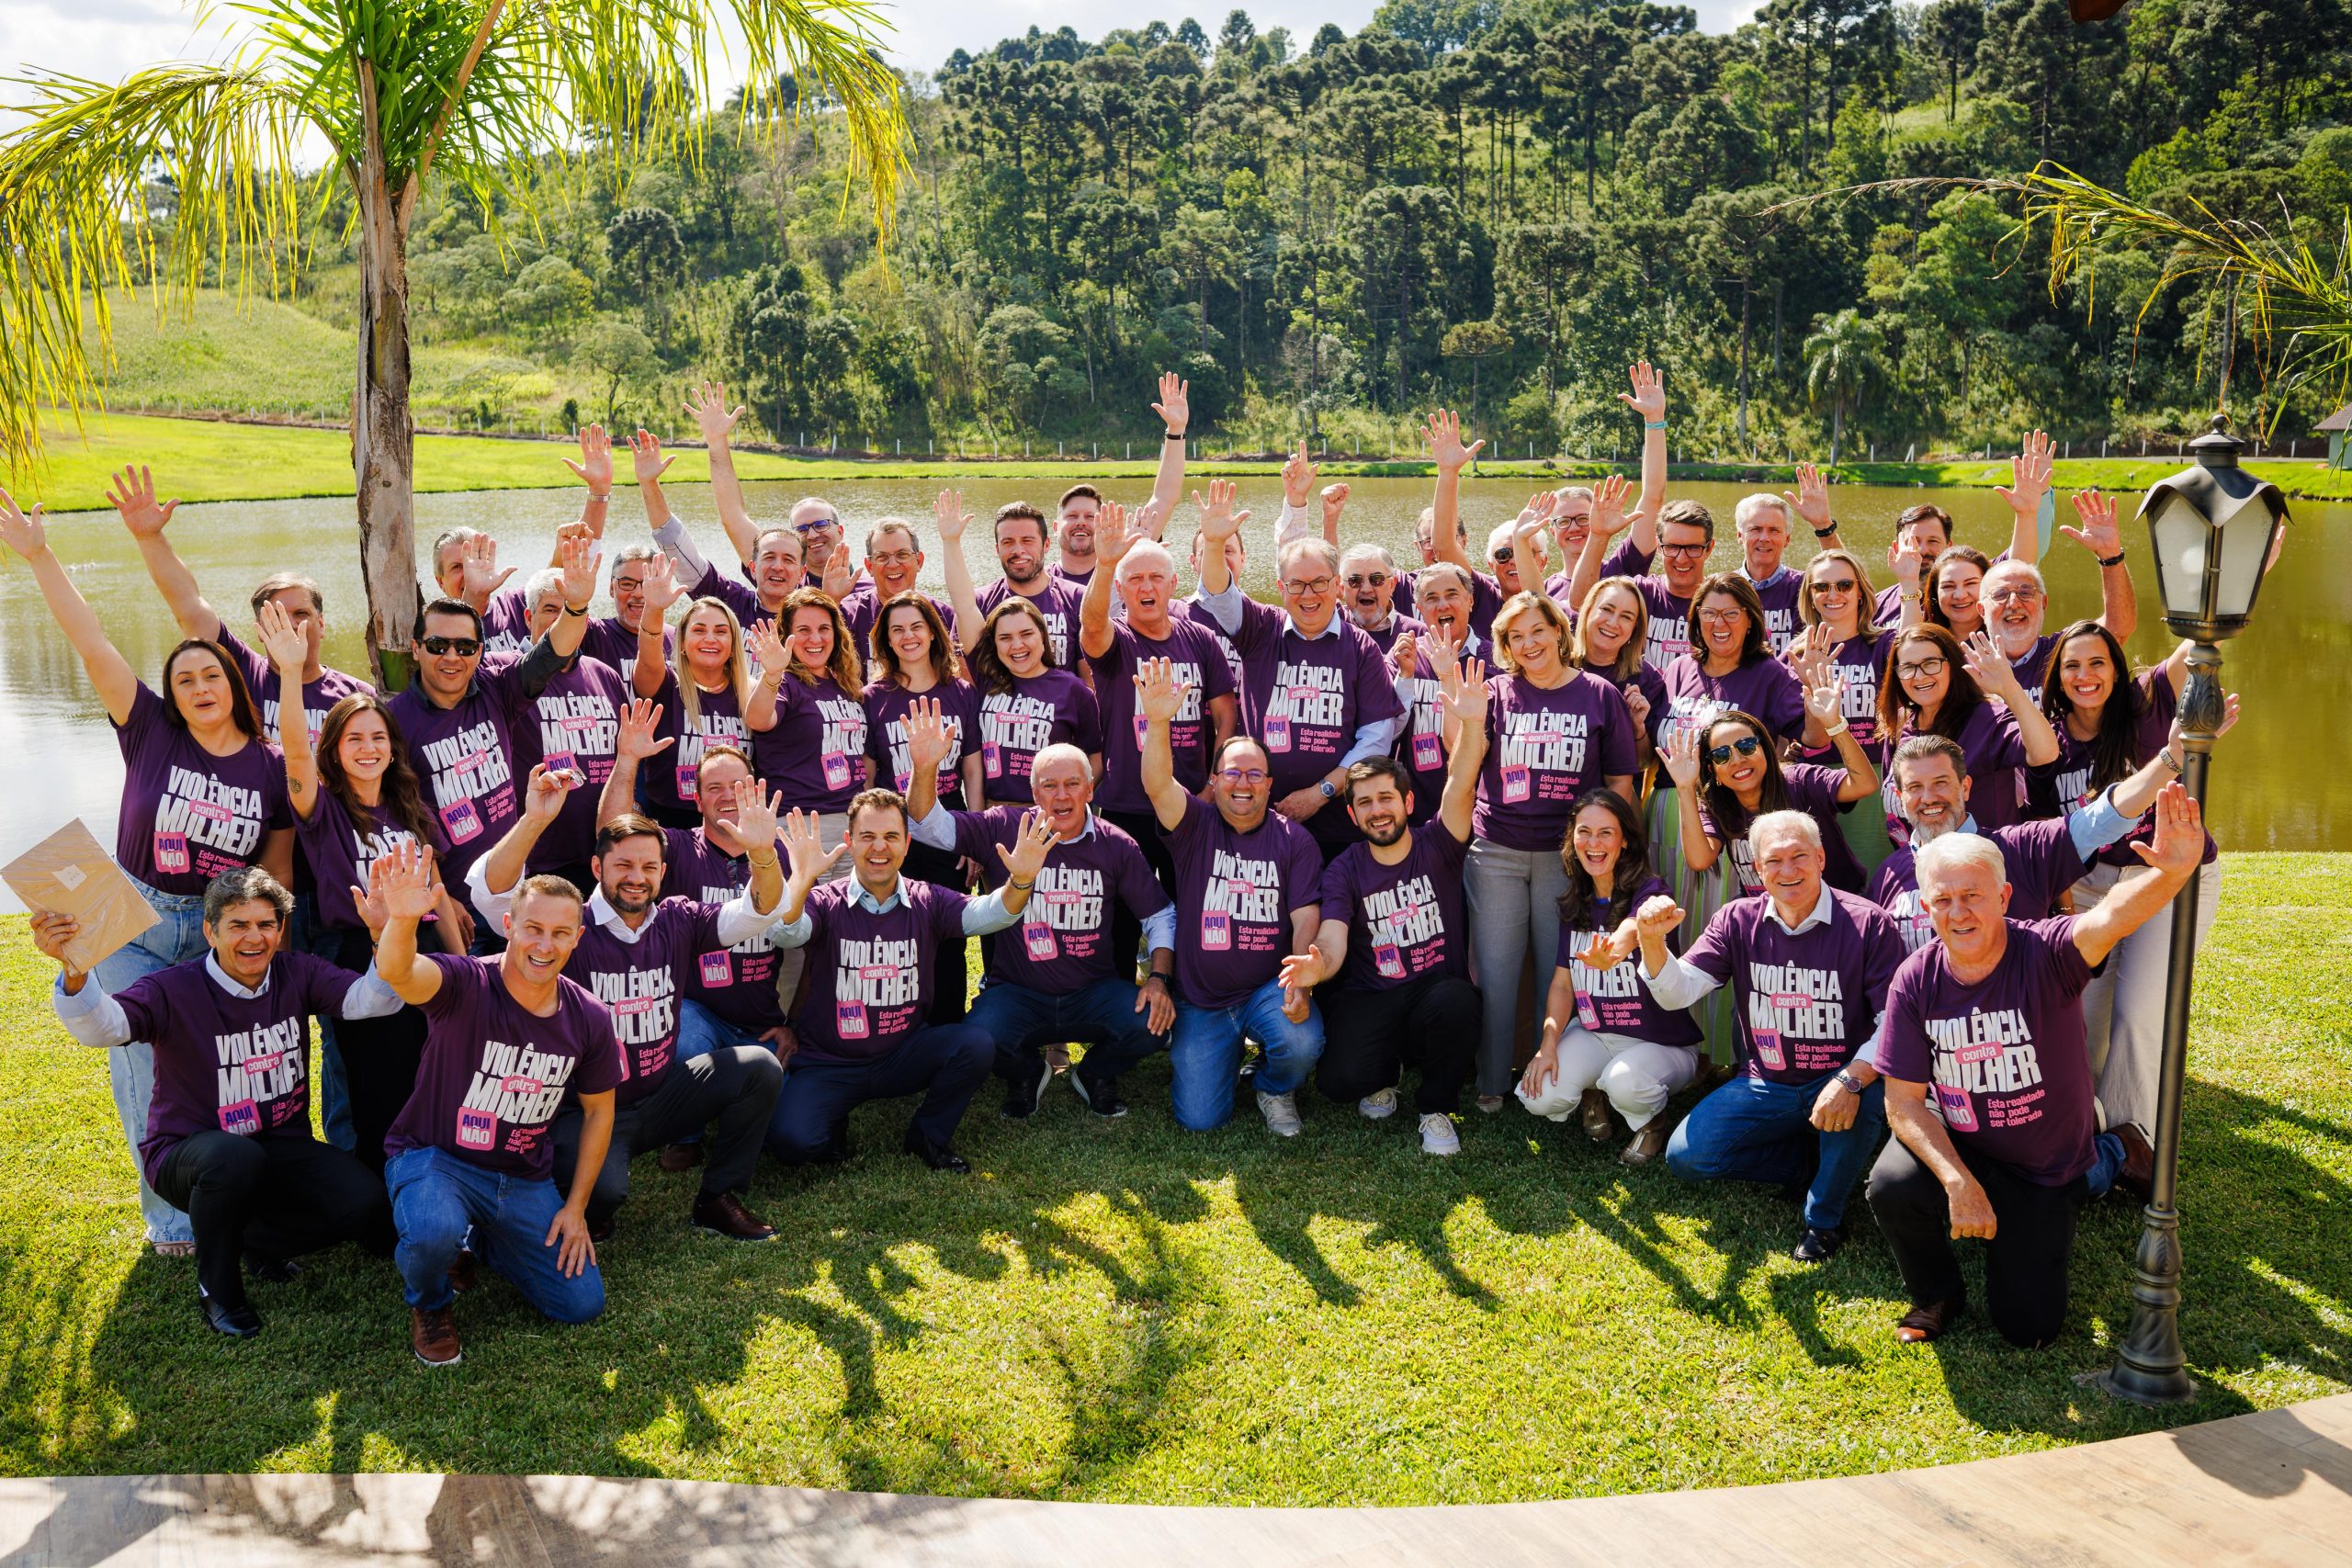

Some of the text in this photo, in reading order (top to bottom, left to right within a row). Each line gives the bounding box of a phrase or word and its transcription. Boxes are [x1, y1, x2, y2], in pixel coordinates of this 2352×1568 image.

[1666, 643, 1690, 651] contra
[537, 691, 616, 721] VIOLÊNCIA
[981, 693, 1055, 722] VIOLÊNCIA
[1265, 686, 1343, 727] MULHER
[566, 720, 592, 728] contra
[1267, 721, 1285, 732] AQUI
[1505, 706, 1588, 737] VIOLÊNCIA
[540, 720, 617, 756] MULHER
[978, 712, 1053, 751] MULHER
[1266, 730, 1286, 747] NÃO
[422, 719, 499, 772] VIOLÊNCIA
[1415, 738, 1435, 751] AQUI
[458, 753, 485, 773] contra
[827, 756, 844, 770] AQUI
[1417, 748, 1437, 765] NÃO
[1500, 735, 1586, 773] MULHER
[548, 756, 571, 772] AQUI
[432, 746, 511, 809] MULHER
[1507, 770, 1525, 784] AQUI
[167, 765, 263, 819] VIOLÊNCIA
[1507, 780, 1525, 797] NÃO
[194, 803, 227, 819] contra
[446, 804, 469, 825] AQUI
[155, 794, 261, 856] MULHER
[452, 817, 477, 838] NÃO
[158, 837, 183, 852] AQUI
[160, 849, 185, 868] NÃO
[1035, 863, 1103, 896] IOLÊNCIA
[1048, 893, 1076, 903] contra
[1204, 876, 1279, 922] MULHER
[1024, 892, 1102, 930] MULHER
[1204, 916, 1225, 928] AQUI
[1238, 926, 1252, 934] Esta
[1028, 927, 1049, 941] AQUI
[1204, 926, 1227, 944] NÃO
[1238, 934, 1267, 943] não pode
[840, 935, 919, 967] VIOLÊNCIA
[1029, 937, 1053, 955] NÃO
[703, 953, 724, 966] AQUI
[705, 964, 728, 982] NÃO
[865, 967, 893, 978] contra
[1749, 959, 1843, 1000] VIOLÊNCIA
[591, 964, 675, 1003] VIOLÊNCIA
[836, 966, 919, 1007] MULHER
[619, 999, 649, 1013] contra
[1776, 996, 1806, 1007] contra
[605, 995, 674, 1044] ULHER
[840, 1005, 862, 1019] AQUI
[1748, 991, 1845, 1039] MULHER
[841, 1017, 864, 1033] NÃO
[1925, 1007, 2032, 1051] VIOLÊNCIA
[1794, 1043, 1810, 1053] Esta
[1795, 1052, 1829, 1062] não pode
[1962, 1046, 1996, 1062] contra
[247, 1055, 279, 1072] contra
[481, 1040, 575, 1087] VIOLÊNCIA
[1795, 1061, 1808, 1069] ser
[1931, 1043, 2042, 1093] MULHER
[217, 1045, 304, 1107] MULHER
[462, 1071, 565, 1124] MULHER
[1987, 1089, 2045, 1109] Esta realidade
[225, 1105, 253, 1124] AQUI
[1945, 1105, 1972, 1124] NÃO
[1989, 1106, 2030, 1118] não pode
[1990, 1110, 2042, 1128] ser tolerada
[462, 1114, 491, 1130] AQUI
[461, 1125, 490, 1145] NÃO
